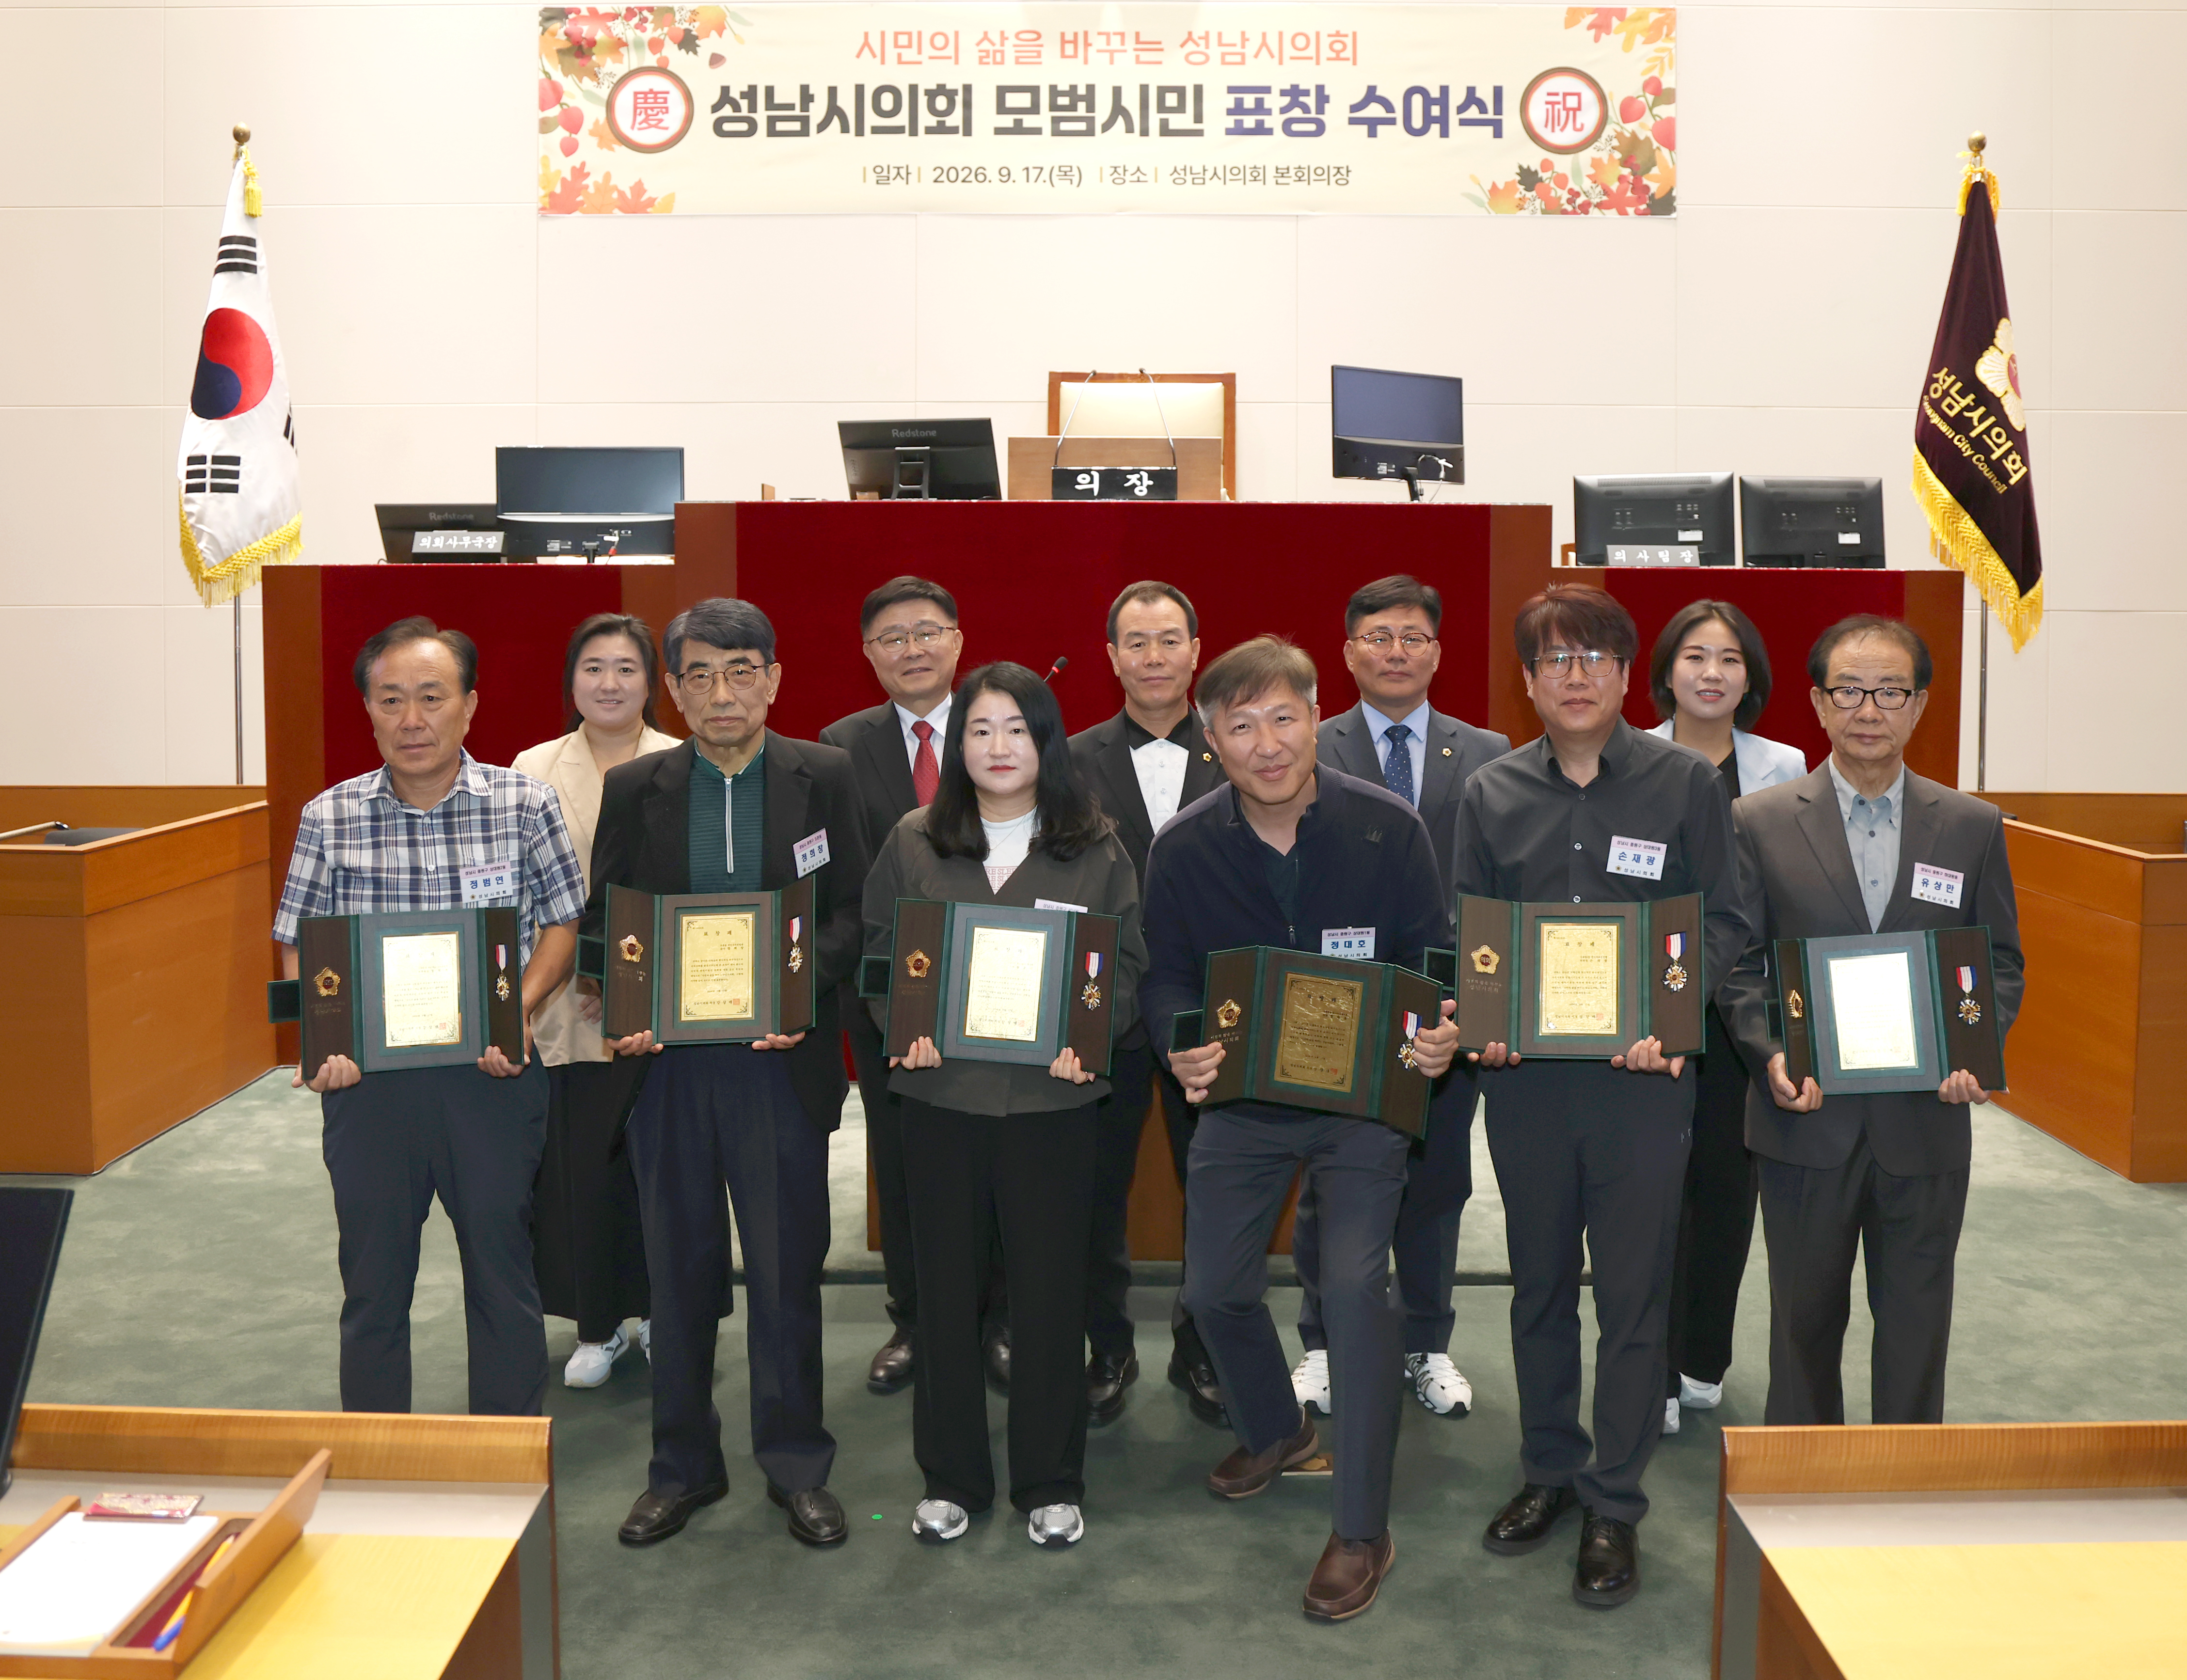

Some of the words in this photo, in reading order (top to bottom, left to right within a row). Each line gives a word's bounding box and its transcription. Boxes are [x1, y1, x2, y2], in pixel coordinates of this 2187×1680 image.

[856, 31, 959, 64] 시민의
[976, 30, 1044, 64] 삶을
[1060, 31, 1164, 64] 바꾸는
[1179, 31, 1357, 65] 성남시의회
[630, 88, 670, 132] 慶
[711, 83, 972, 138] 성남시의회
[994, 84, 1204, 137] 모범시민
[1225, 84, 1330, 137] 표창
[1348, 85, 1503, 139] 수여식
[1544, 92, 1584, 133] 祝
[873, 165, 911, 185] 일자
[933, 167, 991, 183] 2026.
[998, 167, 1015, 183] 9.
[1023, 166, 1081, 187] 17.(목)
[1110, 165, 1147, 185] 장소
[1170, 166, 1265, 185] 성남시의회
[1274, 166, 1351, 185] 본회의장
[891, 428, 937, 438] Redstone
[1929, 366, 2028, 485] 성남시의회
[1953, 434, 1975, 457] City
[1971, 454, 2008, 494] Council
[428, 512, 475, 521] Redstone
[419, 535, 498, 550] 의회사무국장
[1613, 549, 1694, 564] 의사팀장
[1618, 851, 1656, 865] 손재광
[469, 875, 504, 889] 정범연
[1331, 940, 1366, 950] 정대호
